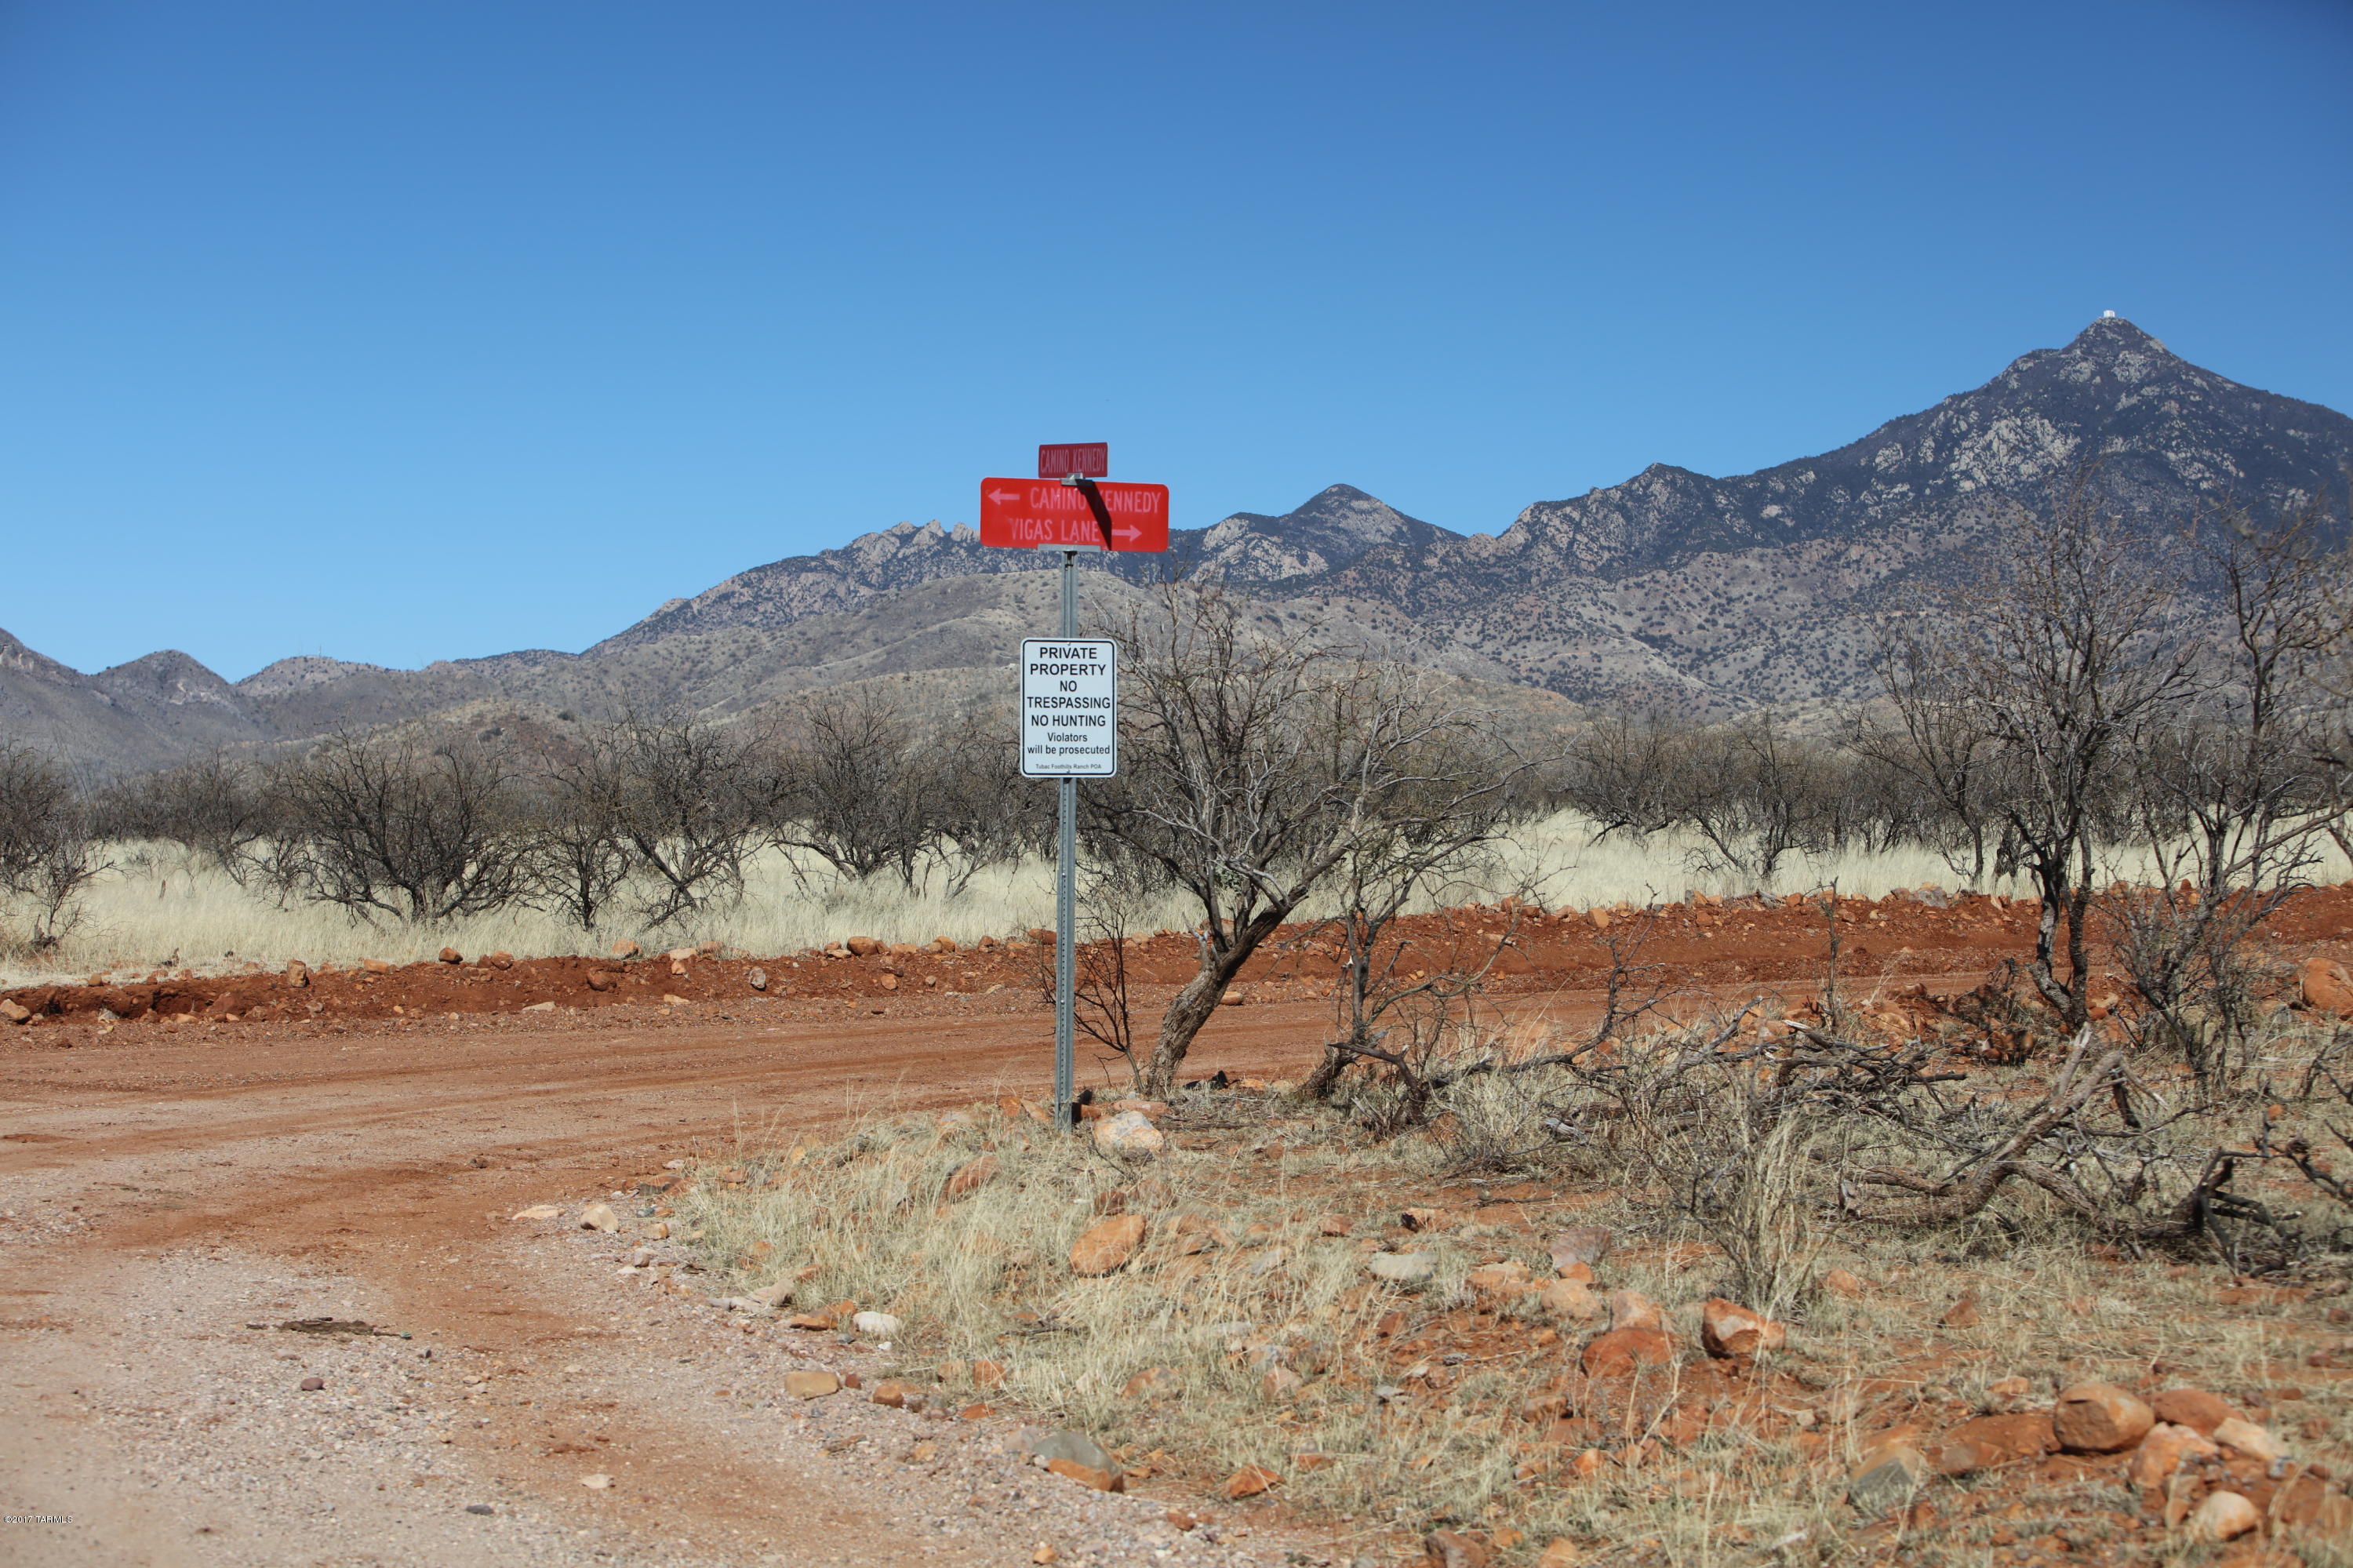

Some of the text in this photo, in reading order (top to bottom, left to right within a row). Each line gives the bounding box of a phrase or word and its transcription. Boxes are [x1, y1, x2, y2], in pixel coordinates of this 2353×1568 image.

[1040, 448, 1106, 473] CAMINO KENNEDY
[1030, 486, 1087, 510] CAMINO
[1010, 518, 1101, 542] VIGAS LANE
[1039, 647, 1097, 659] PRIVATE
[1030, 664, 1107, 675] PROPERTY
[1060, 680, 1078, 692] NO
[1027, 697, 1111, 709] TRESPASSING
[1031, 715, 1106, 726] NO HUNTING
[1047, 732, 1088, 742] Violators
[1027, 744, 1111, 756] will be prosecuted
